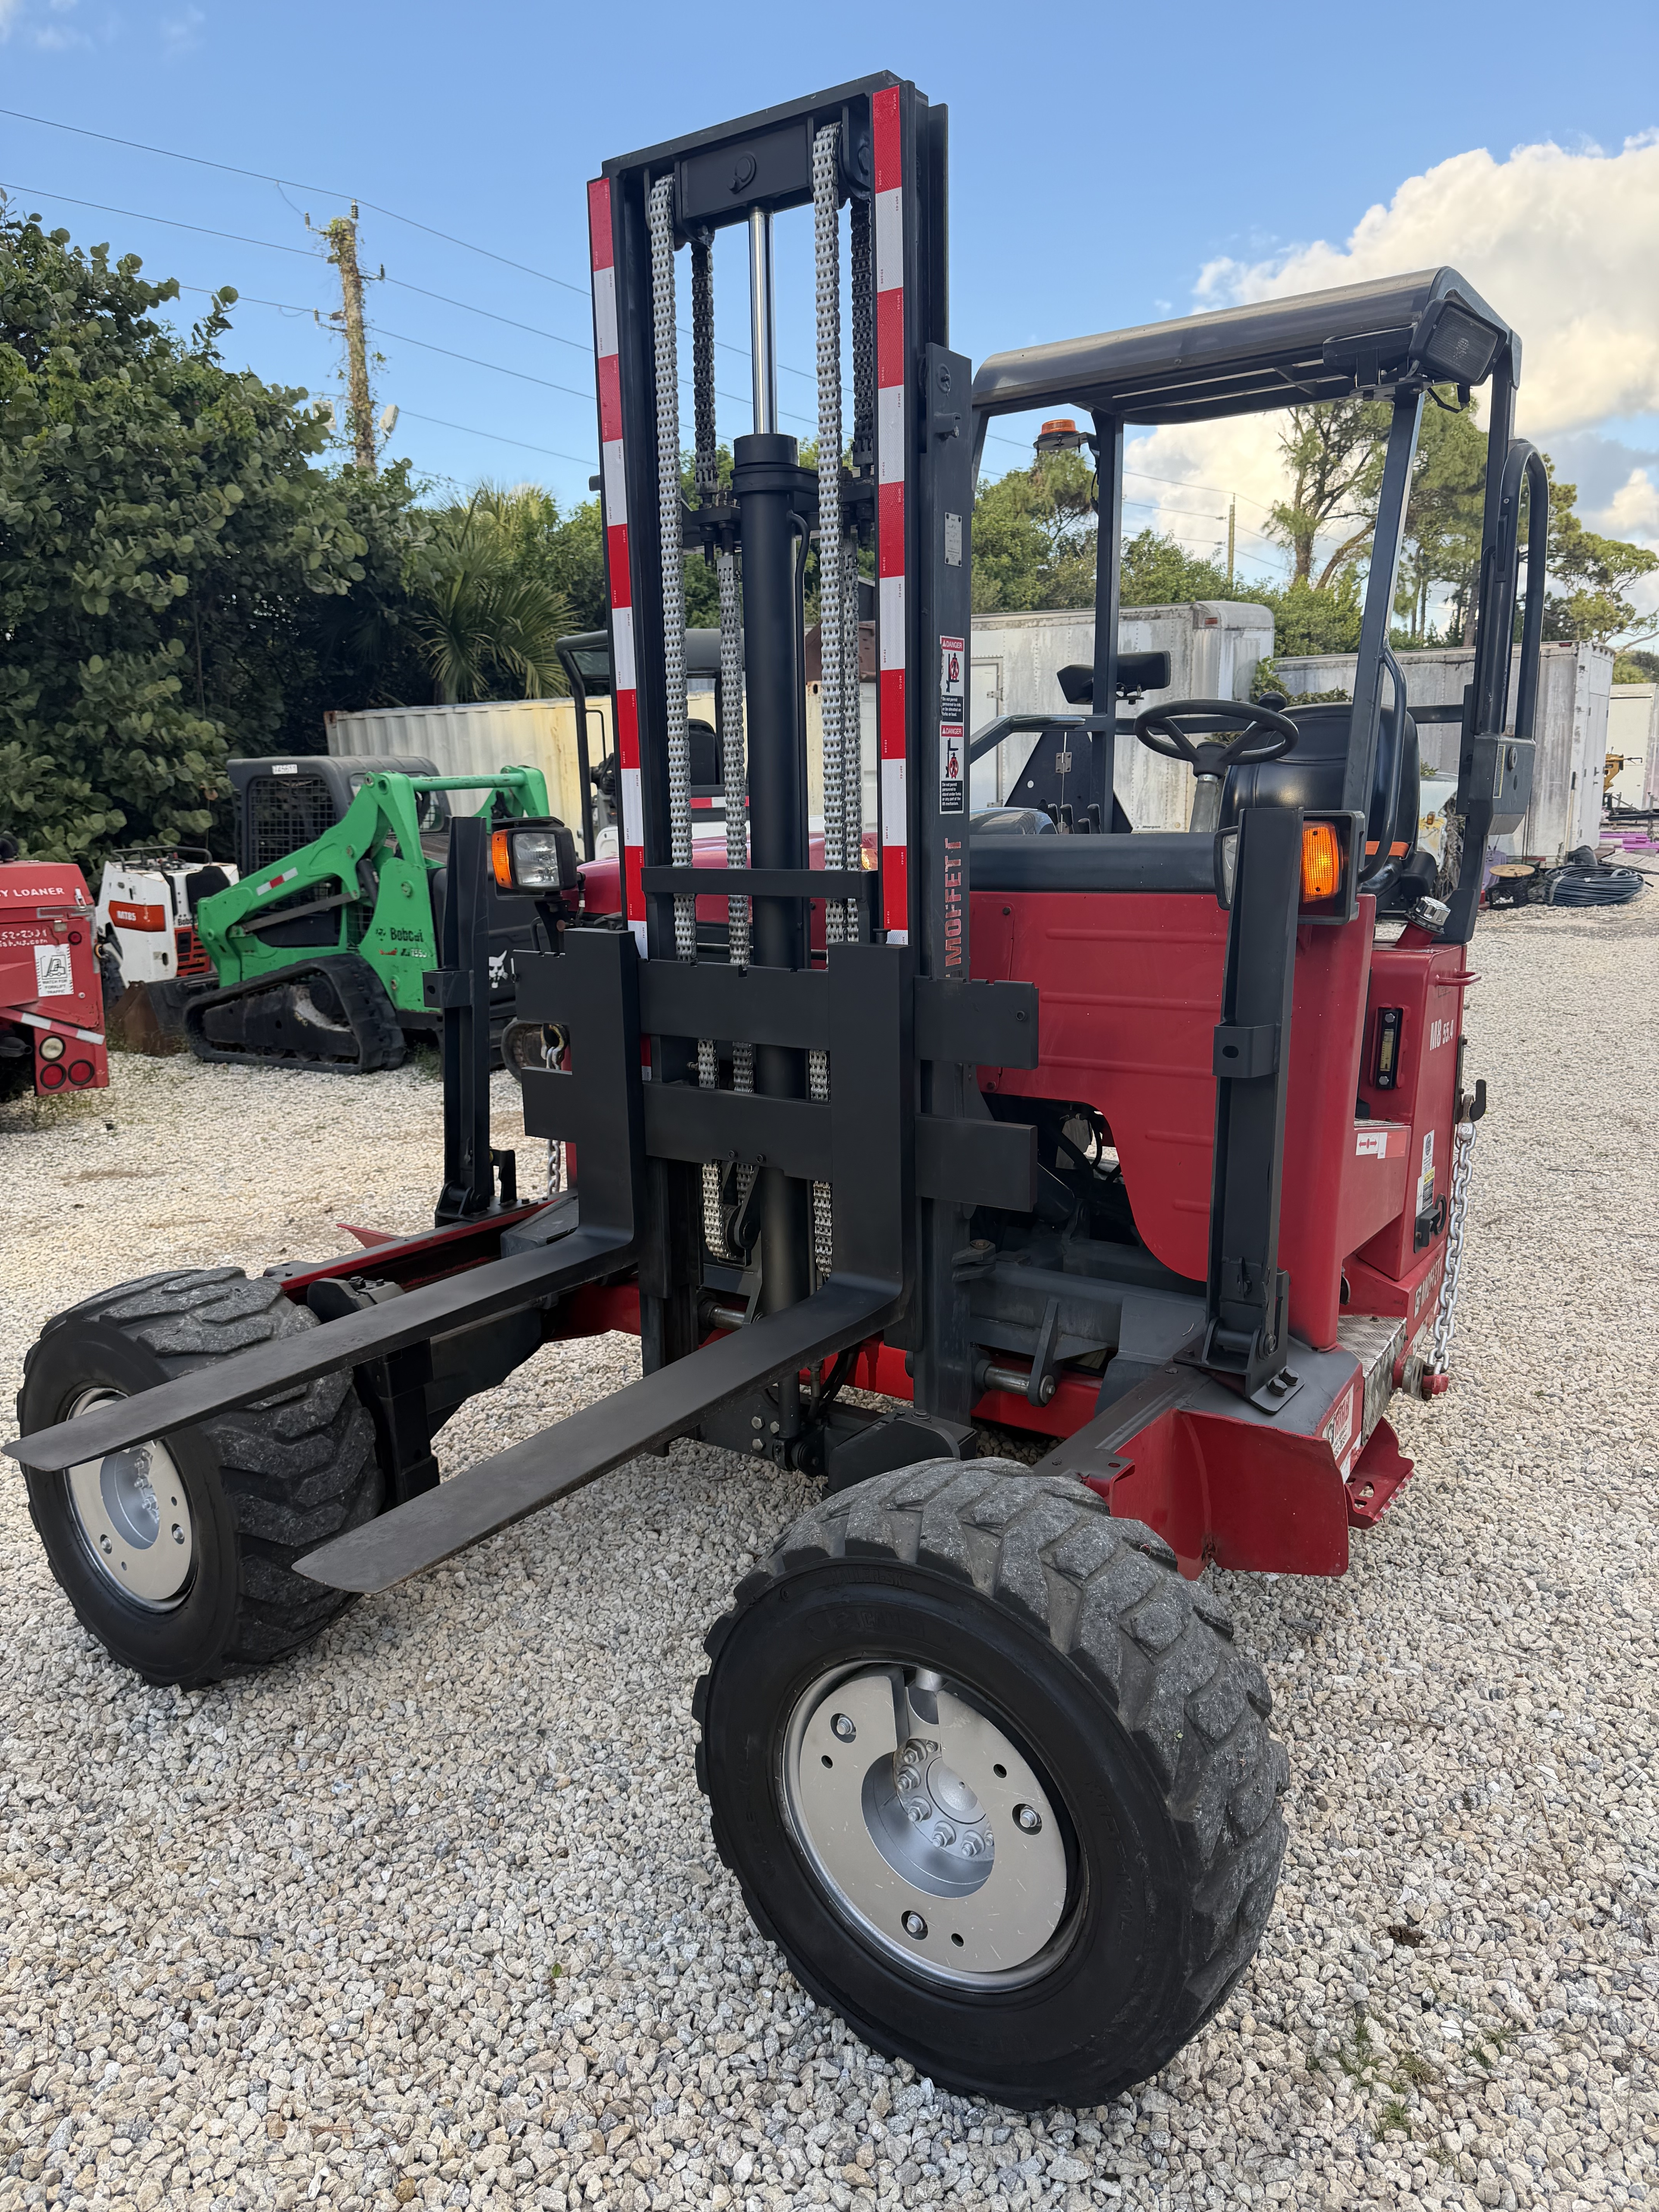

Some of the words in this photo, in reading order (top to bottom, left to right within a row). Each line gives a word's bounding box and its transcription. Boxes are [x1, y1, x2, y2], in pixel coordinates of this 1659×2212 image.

[13, 887, 65, 896] LOANER
[945, 838, 962, 967] MOFFETT
[1430, 1019, 1442, 1051] M8
[1443, 1019, 1454, 1044] 55.4
